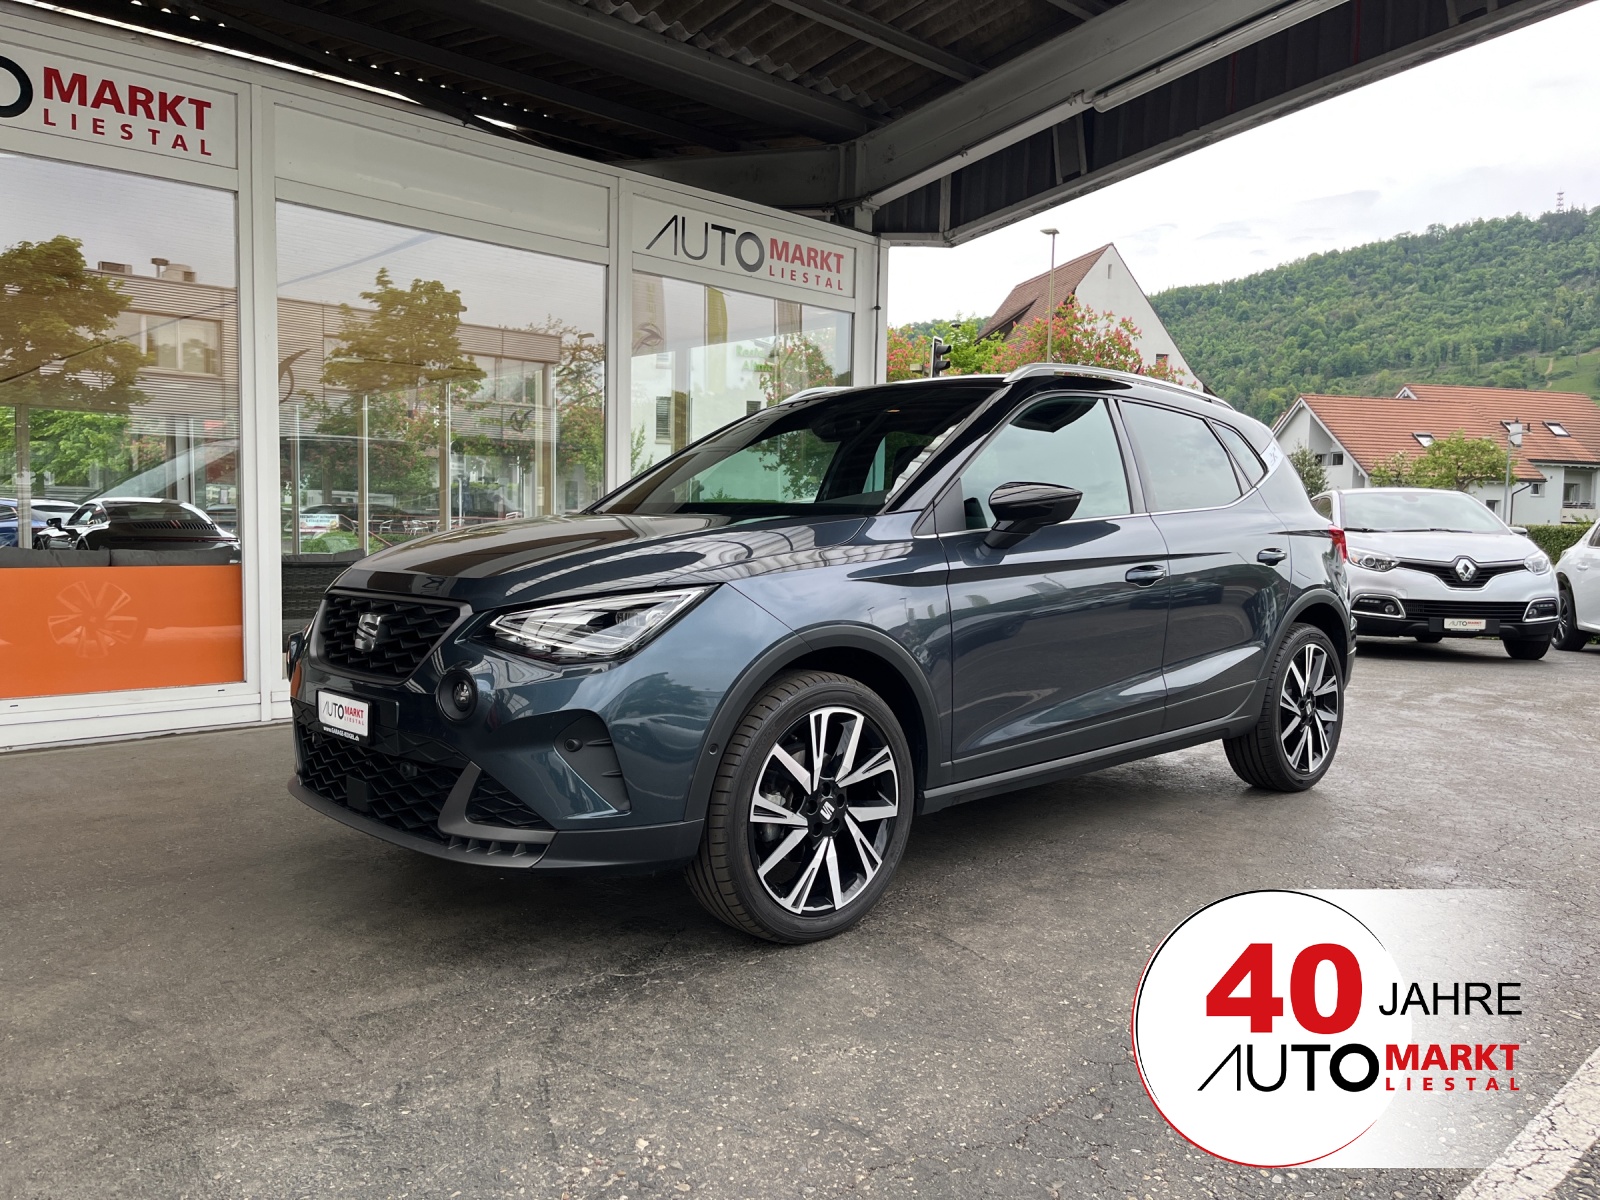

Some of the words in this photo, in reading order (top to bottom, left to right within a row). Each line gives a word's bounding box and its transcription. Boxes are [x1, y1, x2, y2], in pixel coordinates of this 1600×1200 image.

[43, 66, 212, 131] MARKT
[43, 108, 212, 156] LIESTAL
[645, 214, 765, 272] AUTO
[769, 238, 844, 274] MARKT
[769, 265, 843, 291] LIESTAL
[323, 701, 344, 720] AUTO
[344, 706, 364, 719] MARKT
